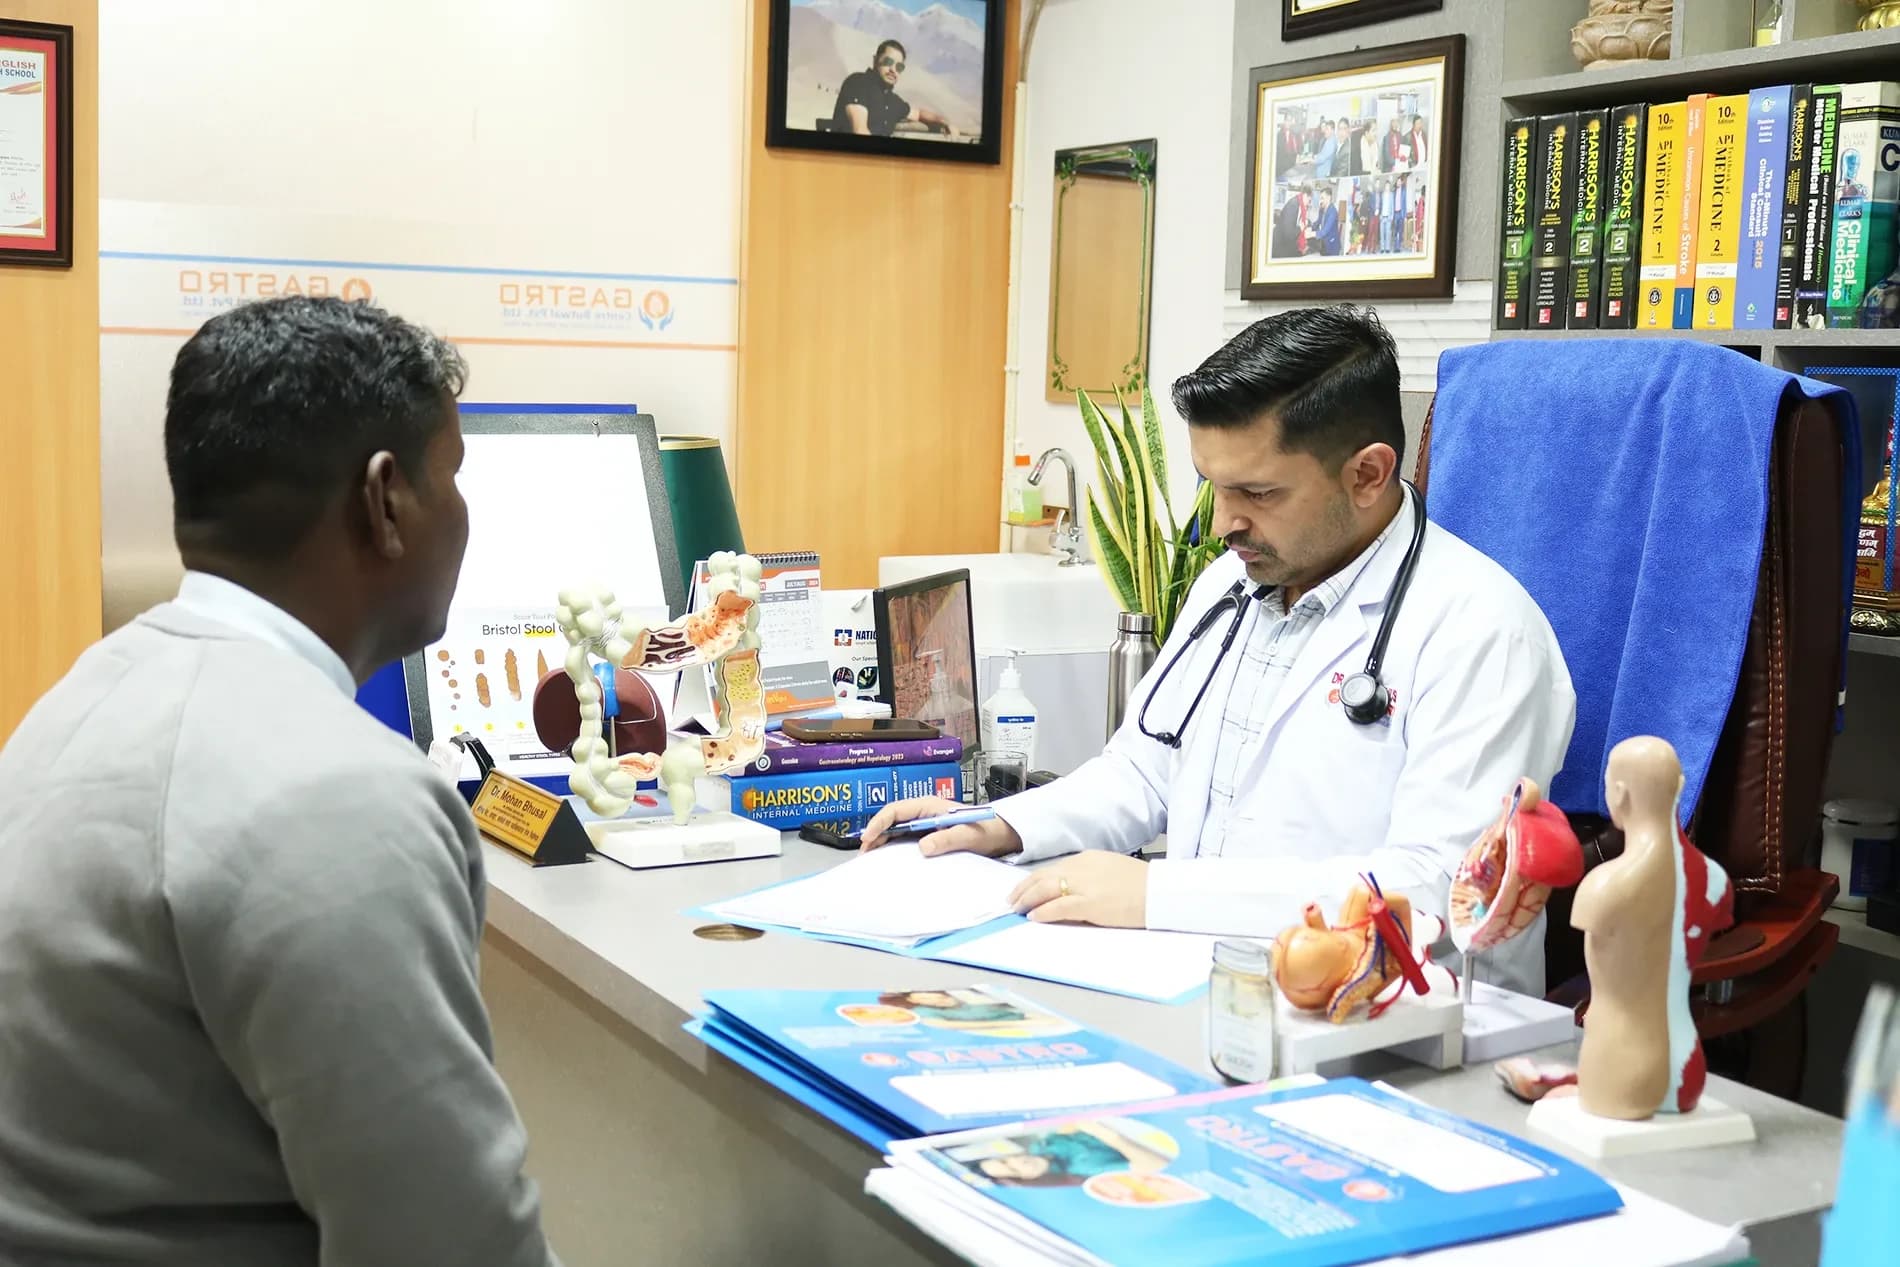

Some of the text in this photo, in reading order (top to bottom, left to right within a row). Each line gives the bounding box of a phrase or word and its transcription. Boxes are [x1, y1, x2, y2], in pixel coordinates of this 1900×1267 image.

[0, 59, 36, 70] GLISH
[5, 68, 36, 79] SCHOOL
[1814, 98, 1824, 128] MCQs
[1657, 140, 1673, 151] API
[1716, 134, 1734, 145] API
[1794, 106, 1805, 161] HARRISON'S
[1813, 129, 1822, 145] for
[1820, 97, 1837, 174] MEDICINE
[1514, 136, 1528, 226] HARRISON'S
[1551, 133, 1564, 211] HARRISON'S
[1585, 129, 1599, 222] HARRISON'S
[1620, 125, 1636, 219] HARRISON'S
[1809, 146, 1821, 194] Medical
[1652, 152, 1667, 235] MEDICINE
[1711, 147, 1727, 232] MEDICINE
[1755, 158, 1767, 237] Clinical Consult
[1762, 169, 1773, 237] The 5-Minute
[1748, 192, 1757, 238] Standard
[1545, 242, 1553, 253] 2
[1579, 239, 1589, 253] 2
[1613, 237, 1624, 251] 2
[1656, 242, 1661, 254] 1
[1713, 239, 1720, 251] 2
[1785, 228, 1792, 239] 1
[1803, 198, 1818, 281] Professionals
[1511, 242, 1517, 256] 1
[1679, 233, 1691, 276] Stroke
[1831, 221, 1848, 301] Medicine
[1845, 220, 1862, 285] Clinical
[482, 623, 521, 636] Bristol
[524, 622, 556, 635] Stool
[491, 785, 500, 799] Dr.
[500, 789, 523, 809] Mohan
[522, 800, 548, 820] Bhusal
[752, 783, 852, 808] HARRISON'S
[871, 786, 886, 802] 2
[752, 803, 853, 820] INTERNAL MEDICINE
[906, 1041, 1088, 1065] GASTRO
